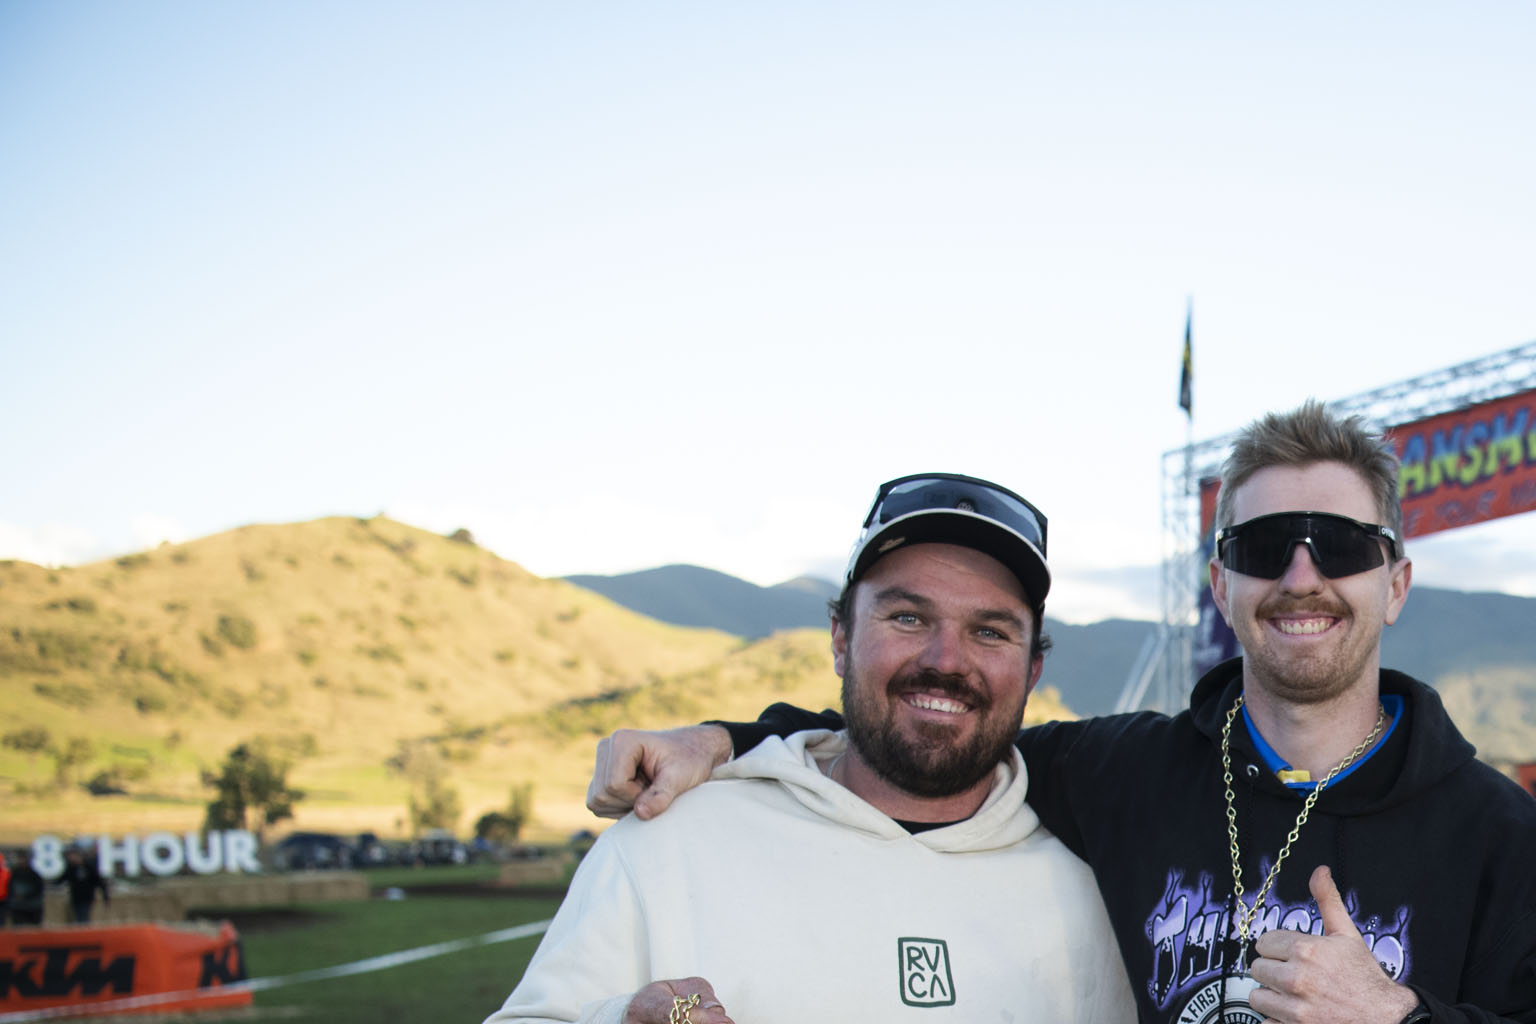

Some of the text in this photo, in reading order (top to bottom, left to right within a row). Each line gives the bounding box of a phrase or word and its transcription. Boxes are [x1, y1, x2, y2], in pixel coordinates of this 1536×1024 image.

[31, 829, 262, 879] 8 HOUR
[1187, 983, 1222, 1019] FIRST
